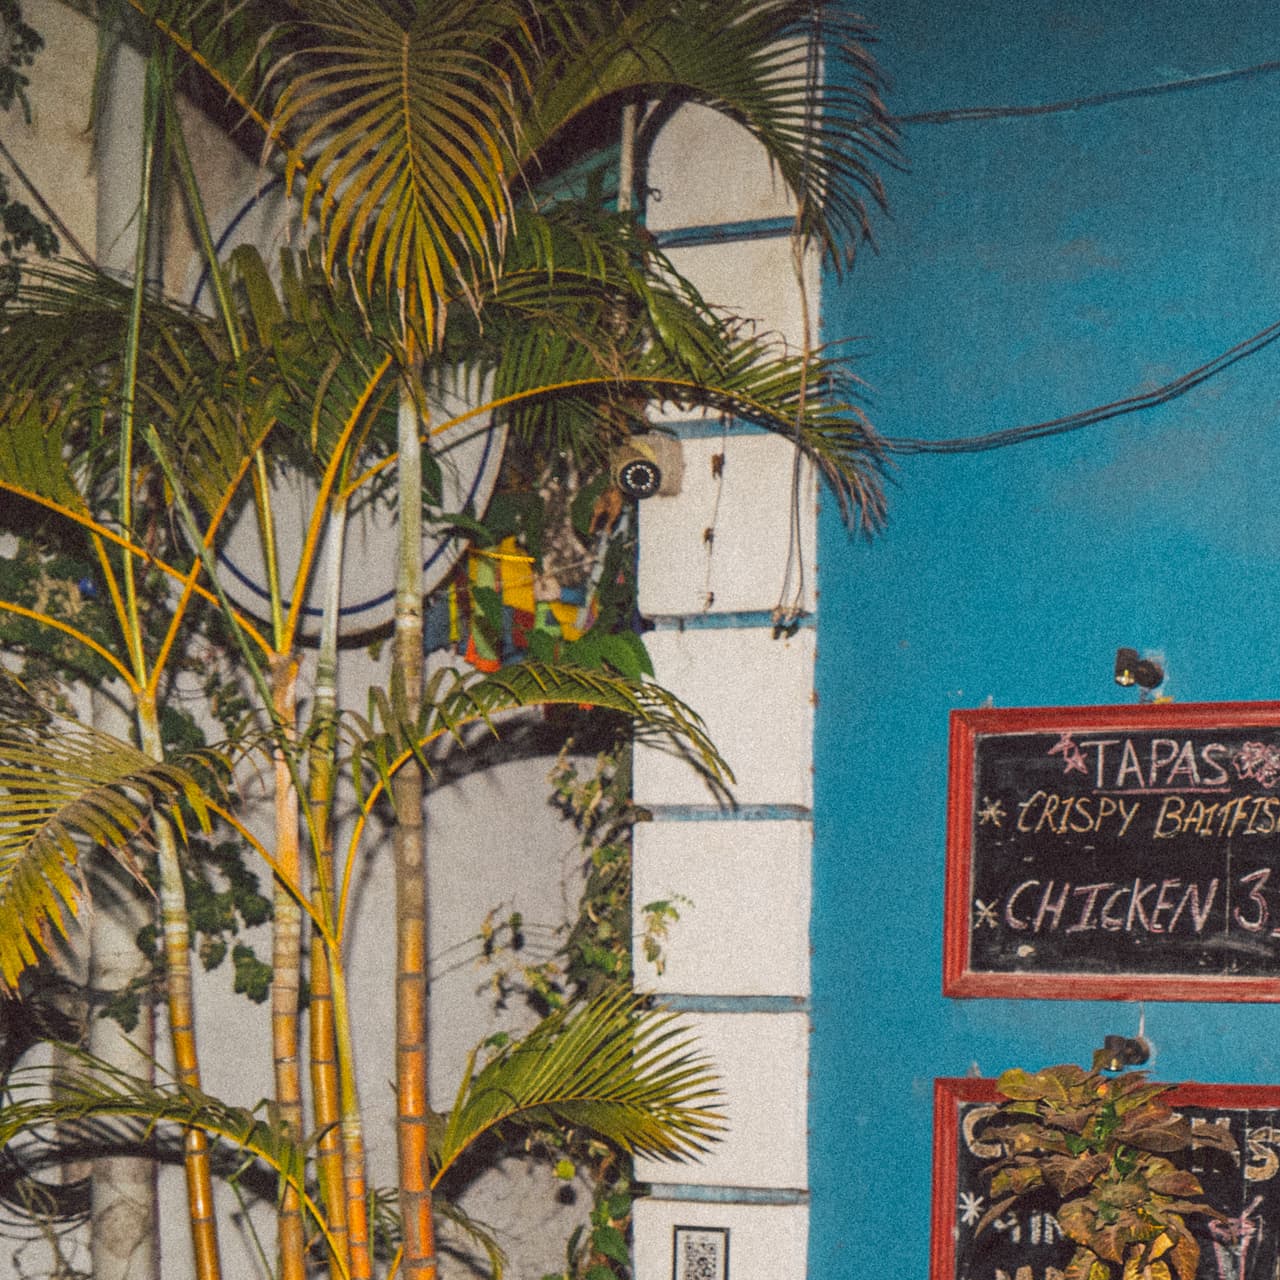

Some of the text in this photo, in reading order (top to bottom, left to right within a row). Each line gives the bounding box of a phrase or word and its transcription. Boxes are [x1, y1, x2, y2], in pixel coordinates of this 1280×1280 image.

[1081, 738, 1230, 788] TAPAS
[1017, 790, 1141, 836] CRISPY
[1006, 878, 1219, 933] CHICKEN
